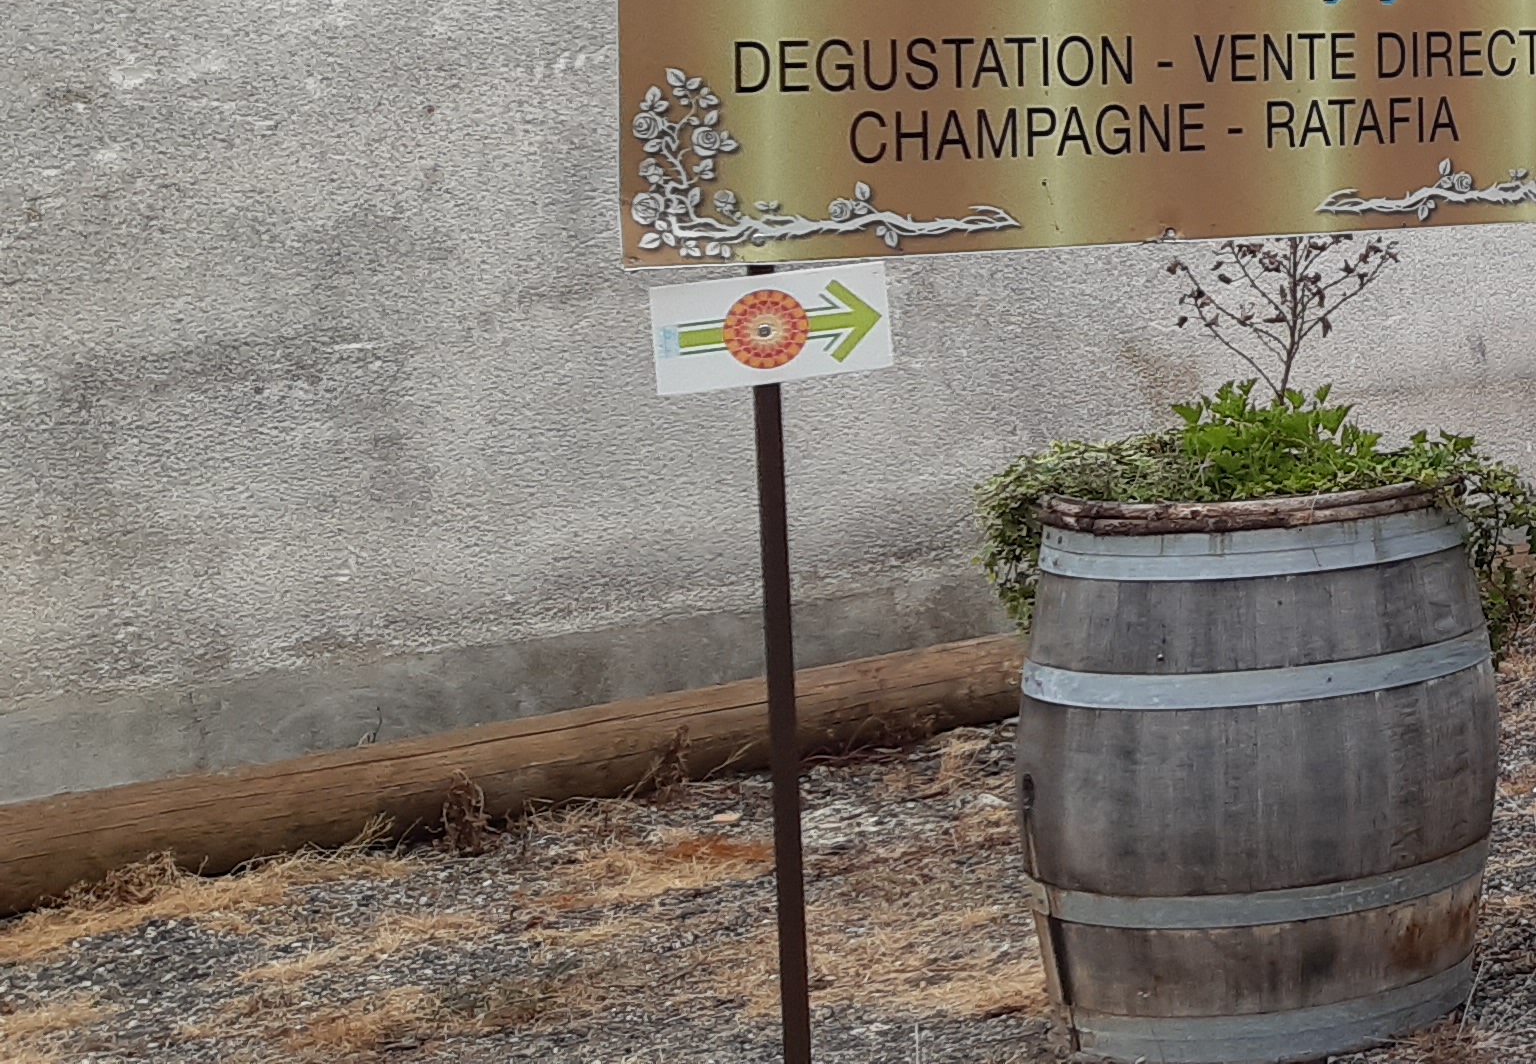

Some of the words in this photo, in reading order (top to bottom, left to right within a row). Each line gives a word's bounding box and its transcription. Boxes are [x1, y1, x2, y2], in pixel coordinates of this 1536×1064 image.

[733, 35, 1135, 95] DEGUSTATION
[1197, 31, 1357, 84] VENTE
[848, 100, 1206, 165] CHAMPAGNE
[1265, 95, 1460, 150] RATAFIA
